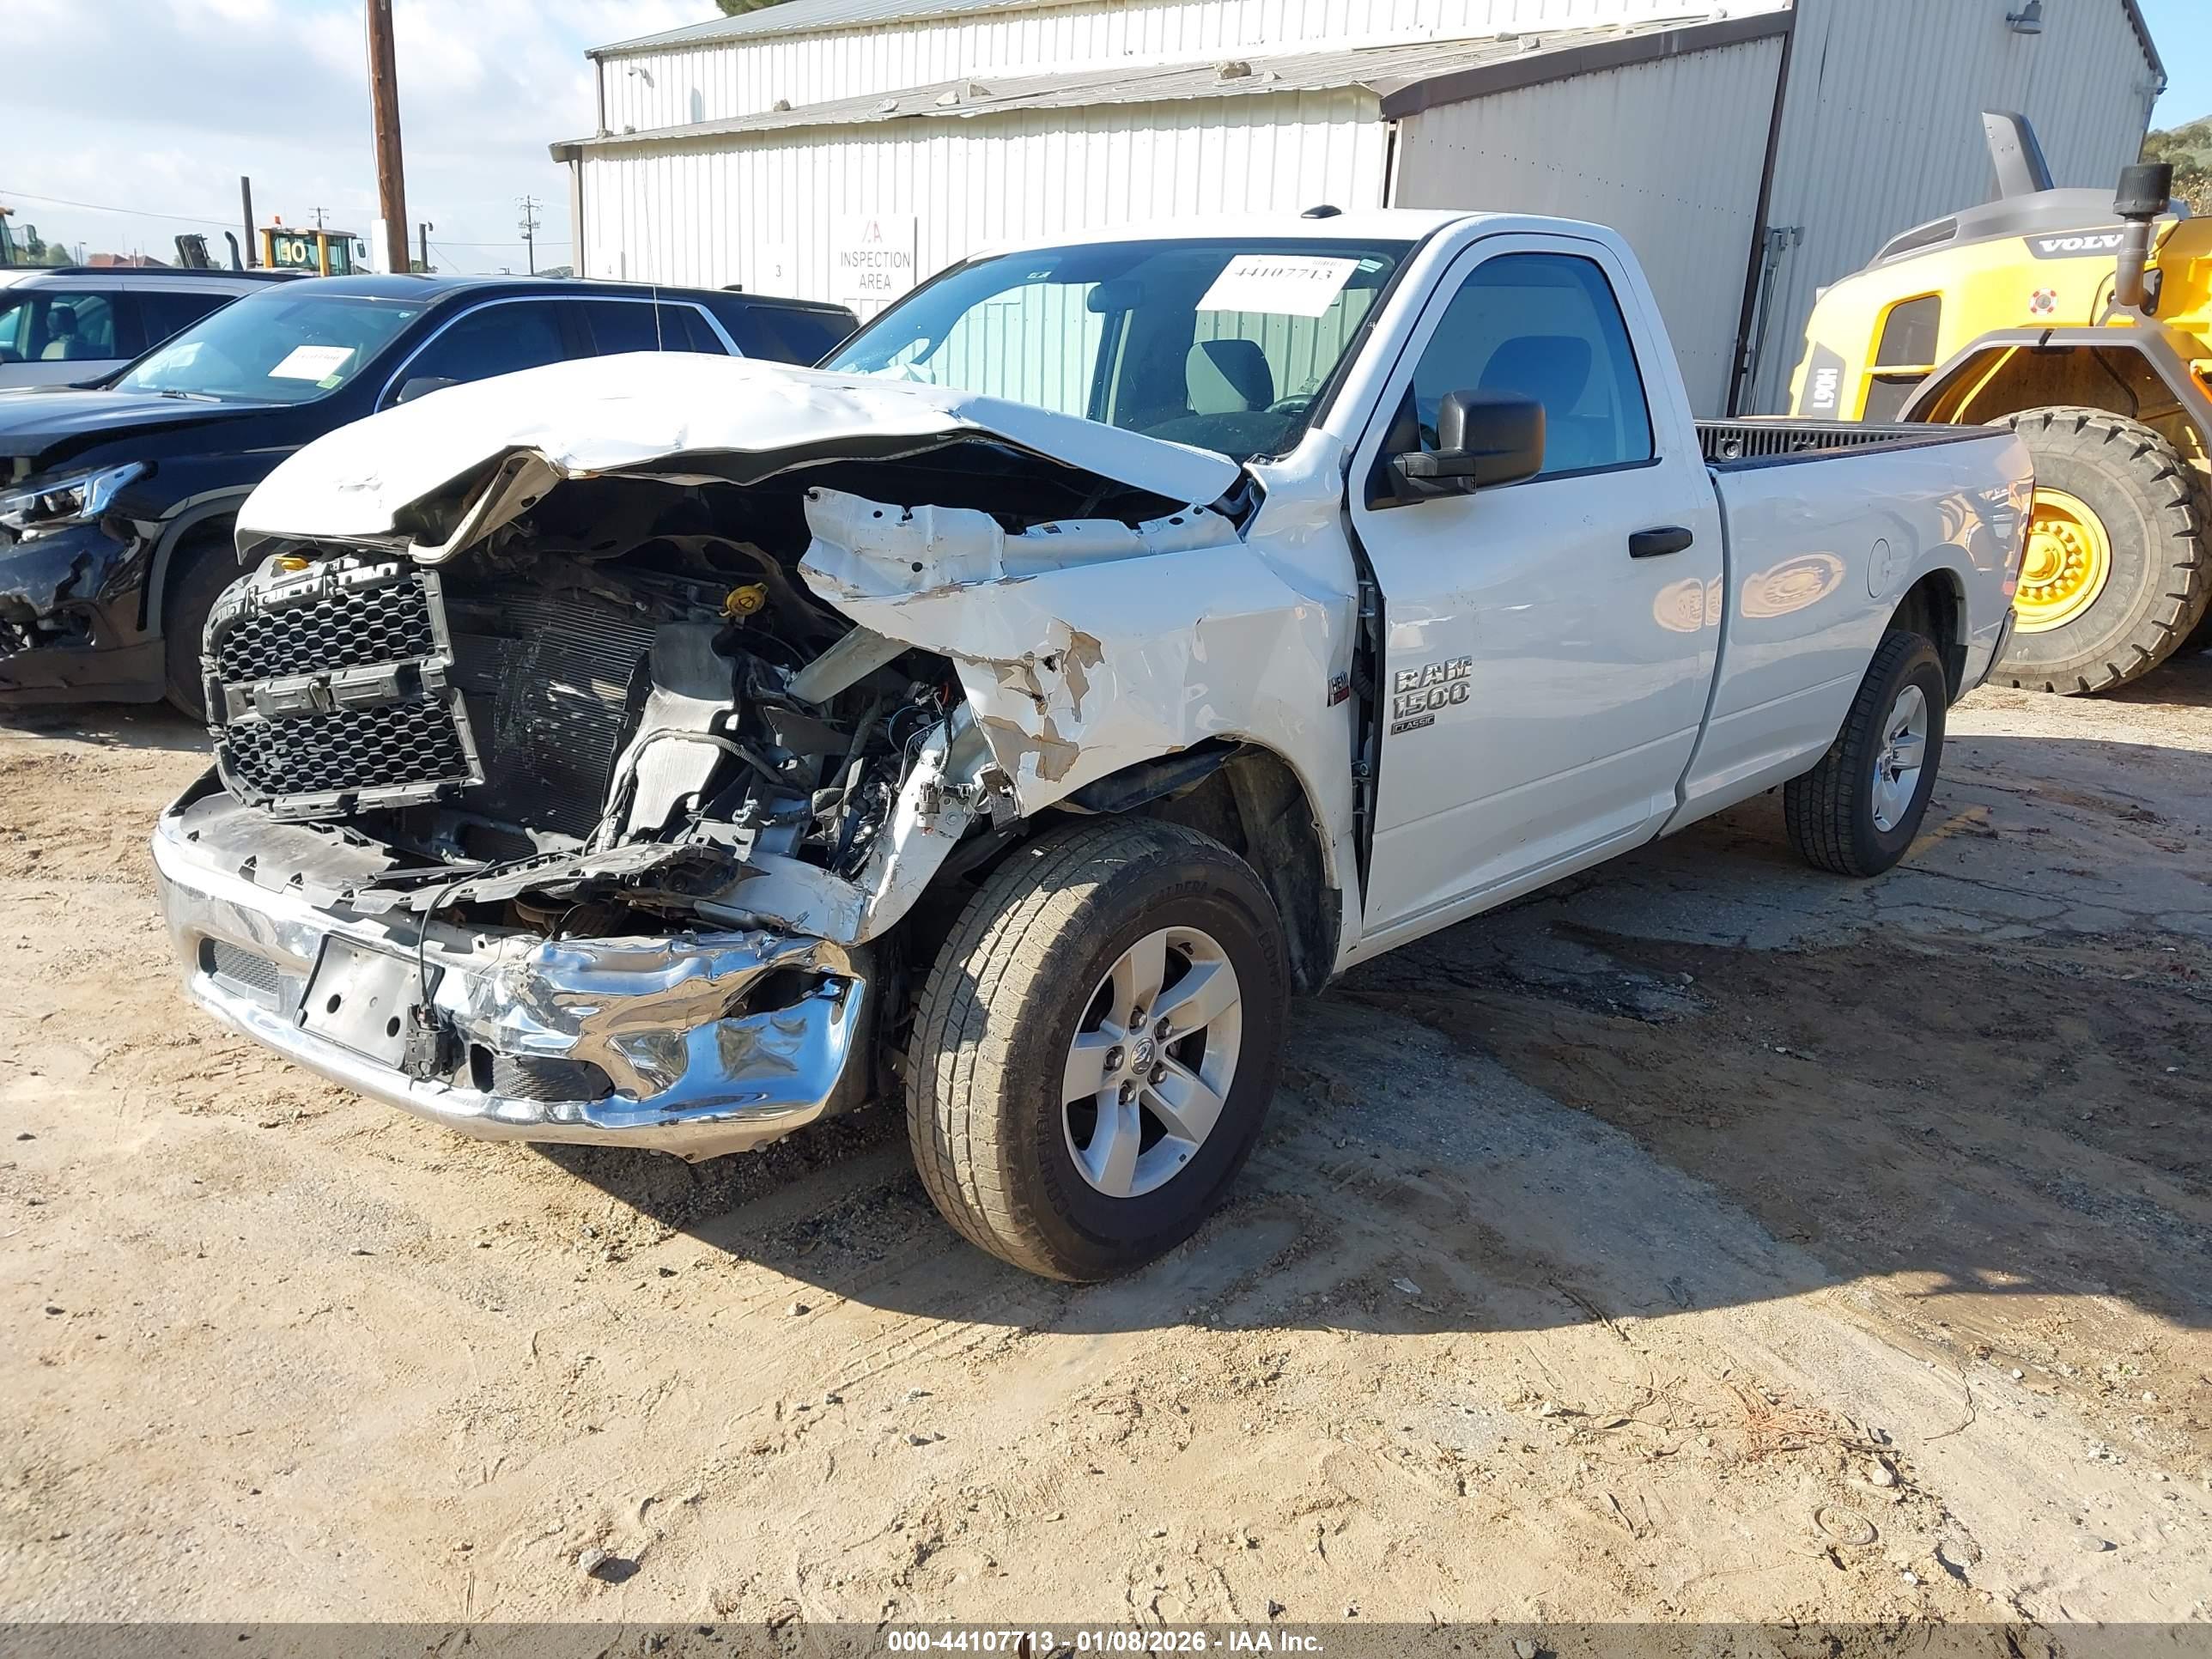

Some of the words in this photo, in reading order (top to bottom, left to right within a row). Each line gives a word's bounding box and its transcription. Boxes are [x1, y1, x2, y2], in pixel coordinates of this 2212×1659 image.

[2039, 234, 2124, 252] VOLV
[841, 251, 910, 268] INSPECTION
[775, 264, 781, 277] 3
[859, 273, 891, 289] AREA
[1394, 656, 1472, 695] RAM
[1394, 681, 1471, 720] 1500
[1394, 714, 1435, 732] CLASSIC
